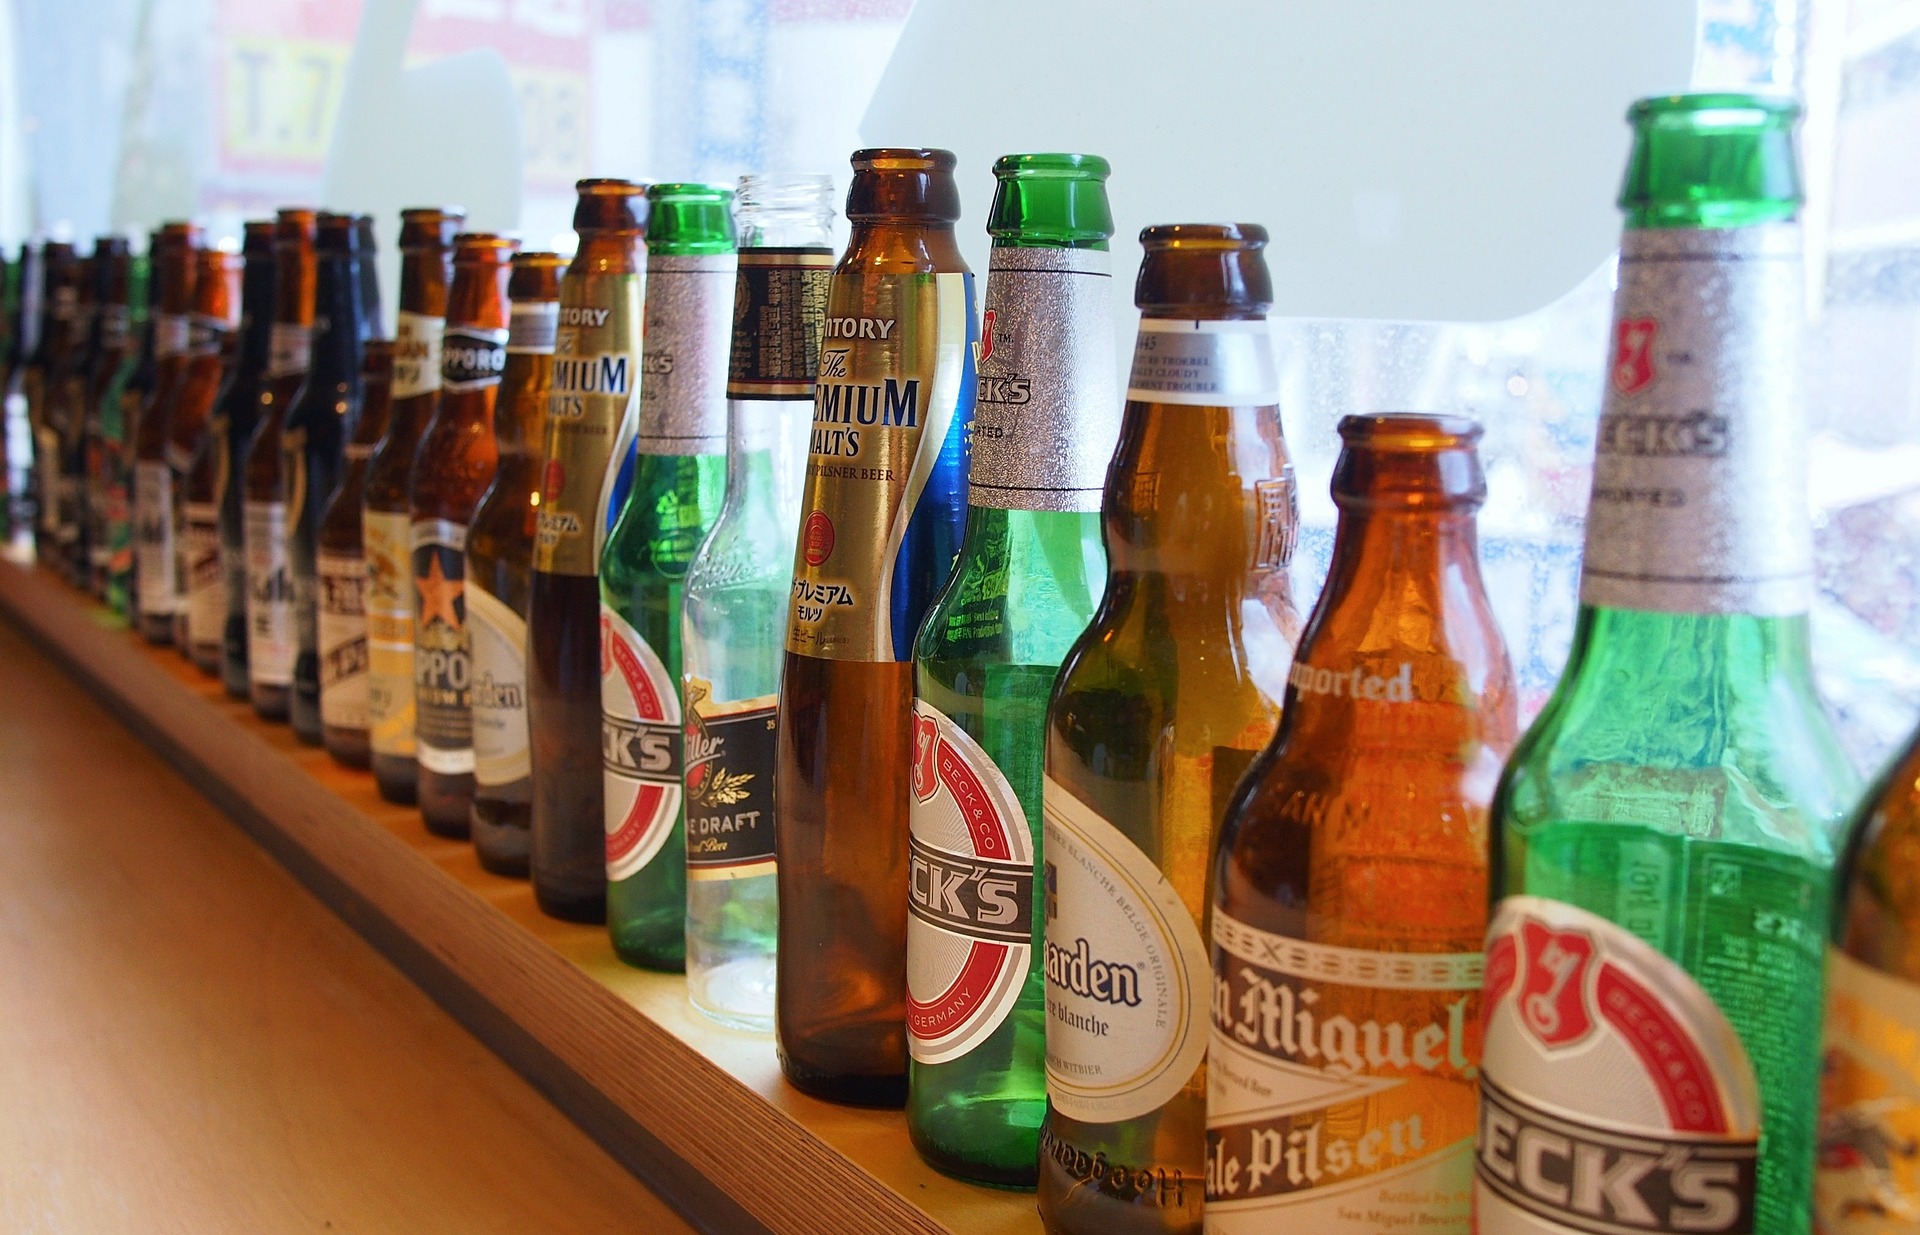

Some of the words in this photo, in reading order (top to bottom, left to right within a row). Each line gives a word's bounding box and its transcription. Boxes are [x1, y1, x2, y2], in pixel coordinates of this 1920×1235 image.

[820, 348, 850, 378] The
[816, 465, 858, 480] PILSNER
[861, 468, 896, 482] BEER
[798, 605, 823, 623] モルツ
[604, 724, 672, 772] K'S
[700, 811, 760, 835] DRAFT
[1068, 846, 1117, 897] BLANCHE
[1116, 895, 1149, 942] BELGE
[1146, 943, 1168, 1029] ORIGINALE
[914, 987, 972, 1028] GERMANY
[1058, 1001, 1110, 1037] blanche
[1235, 966, 1472, 1077] Miguel
[1063, 1061, 1103, 1076] WITBIER
[1246, 1113, 1425, 1193] Pilsen
[1484, 1100, 1740, 1232] ECK'S
